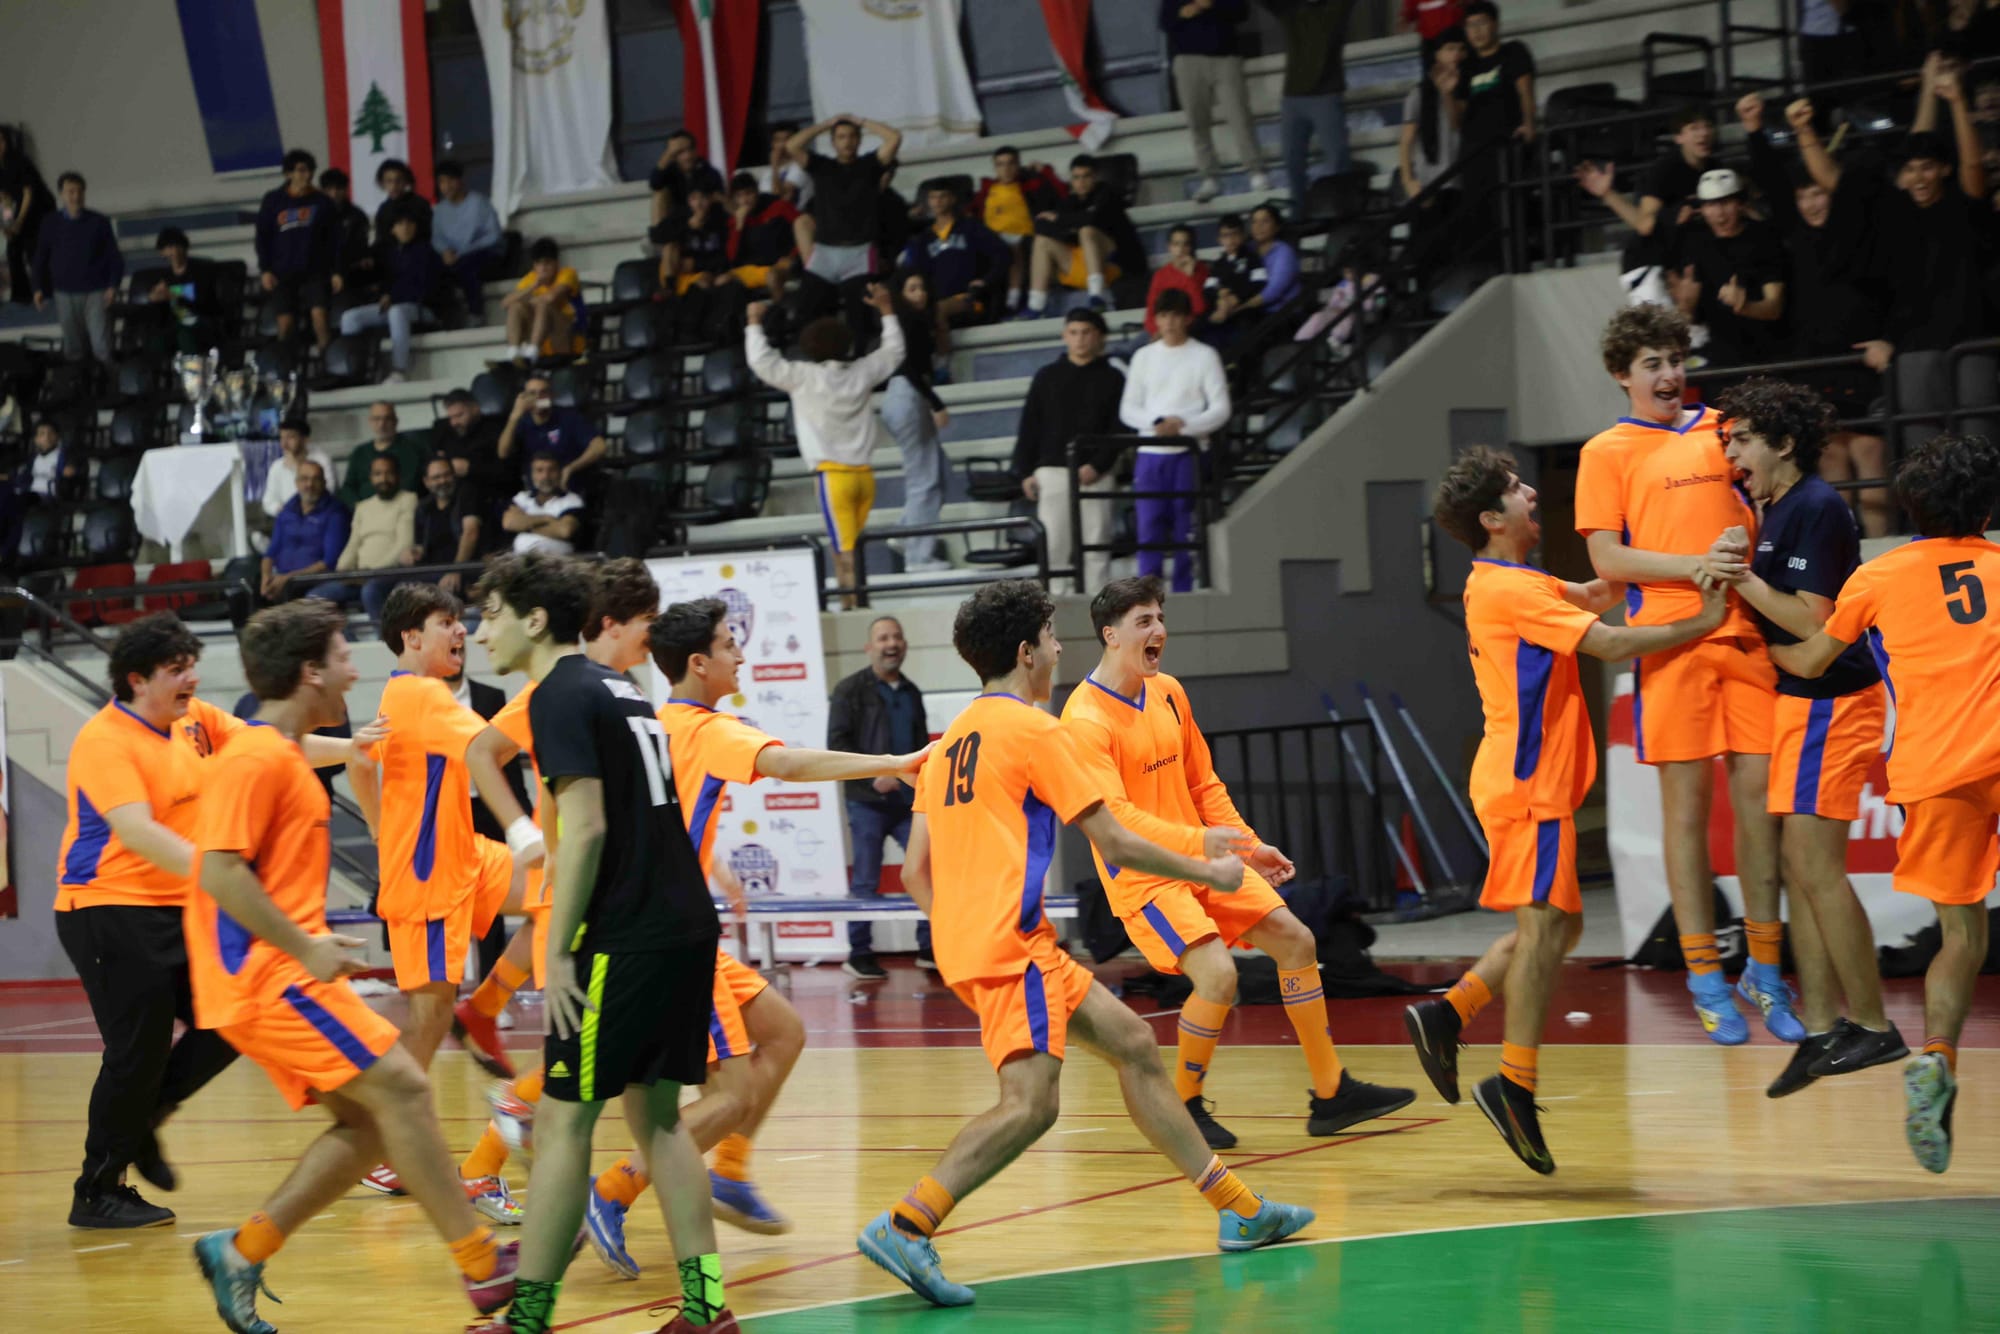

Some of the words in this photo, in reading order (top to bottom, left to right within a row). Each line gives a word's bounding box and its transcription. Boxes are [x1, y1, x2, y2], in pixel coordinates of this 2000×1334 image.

[1664, 473, 1725, 489] Jamhour
[1788, 556, 1807, 570] U18
[1938, 560, 1987, 625] 5
[944, 731, 981, 807] 19
